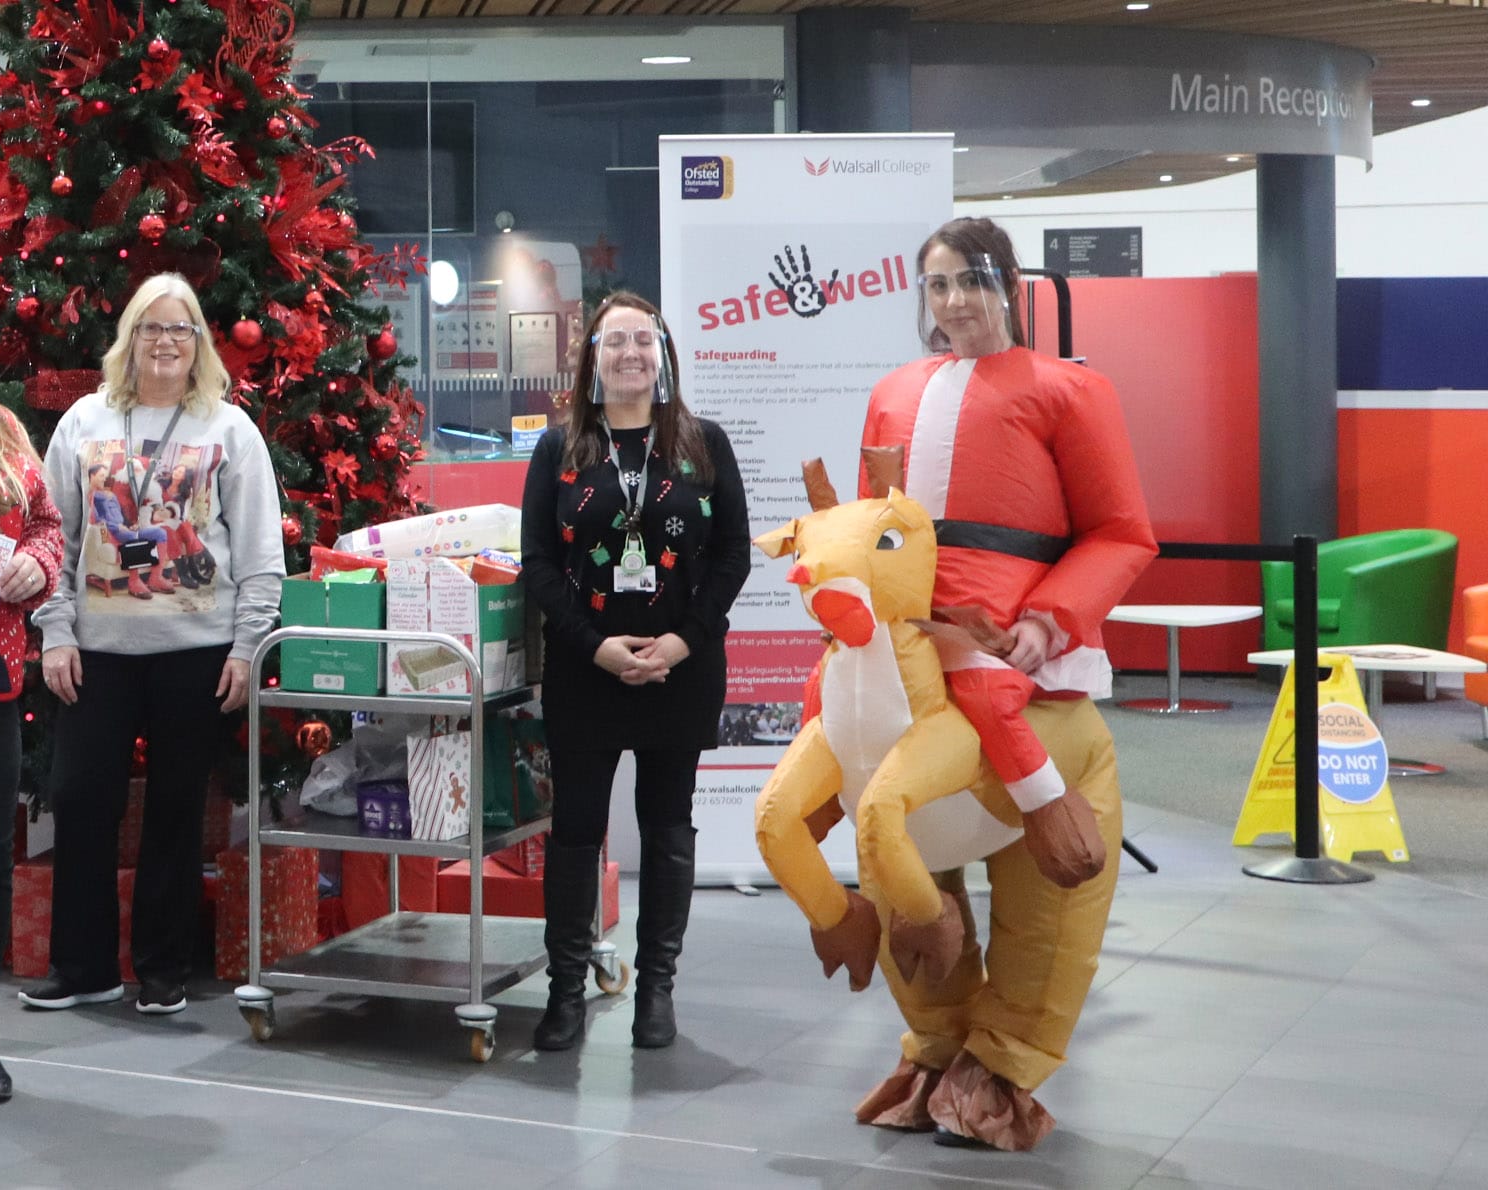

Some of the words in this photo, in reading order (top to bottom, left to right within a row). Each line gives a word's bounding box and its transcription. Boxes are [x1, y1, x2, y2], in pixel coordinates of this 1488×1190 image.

[1170, 73, 1248, 113] Main
[1260, 76, 1356, 127] Reception
[684, 167, 720, 179] Ofsted
[833, 159, 880, 174] Walsall
[882, 159, 931, 175] College
[1050, 238, 1058, 250] 4
[698, 284, 789, 331] safe
[818, 255, 908, 305] well
[694, 350, 777, 362] Safeguarding
[740, 638, 754, 646] that
[771, 637, 786, 645] look
[788, 637, 806, 645] after
[731, 666, 744, 674] the
[744, 666, 792, 675] Safeguarding
[793, 666, 811, 674] Team
[1318, 714, 1364, 727] SOCIAL
[1321, 729, 1366, 737] DISTANCING
[1318, 755, 1342, 770] DO
[1346, 755, 1378, 771] NOT
[1332, 773, 1371, 785] ENTER
[709, 796, 743, 805] 657000
